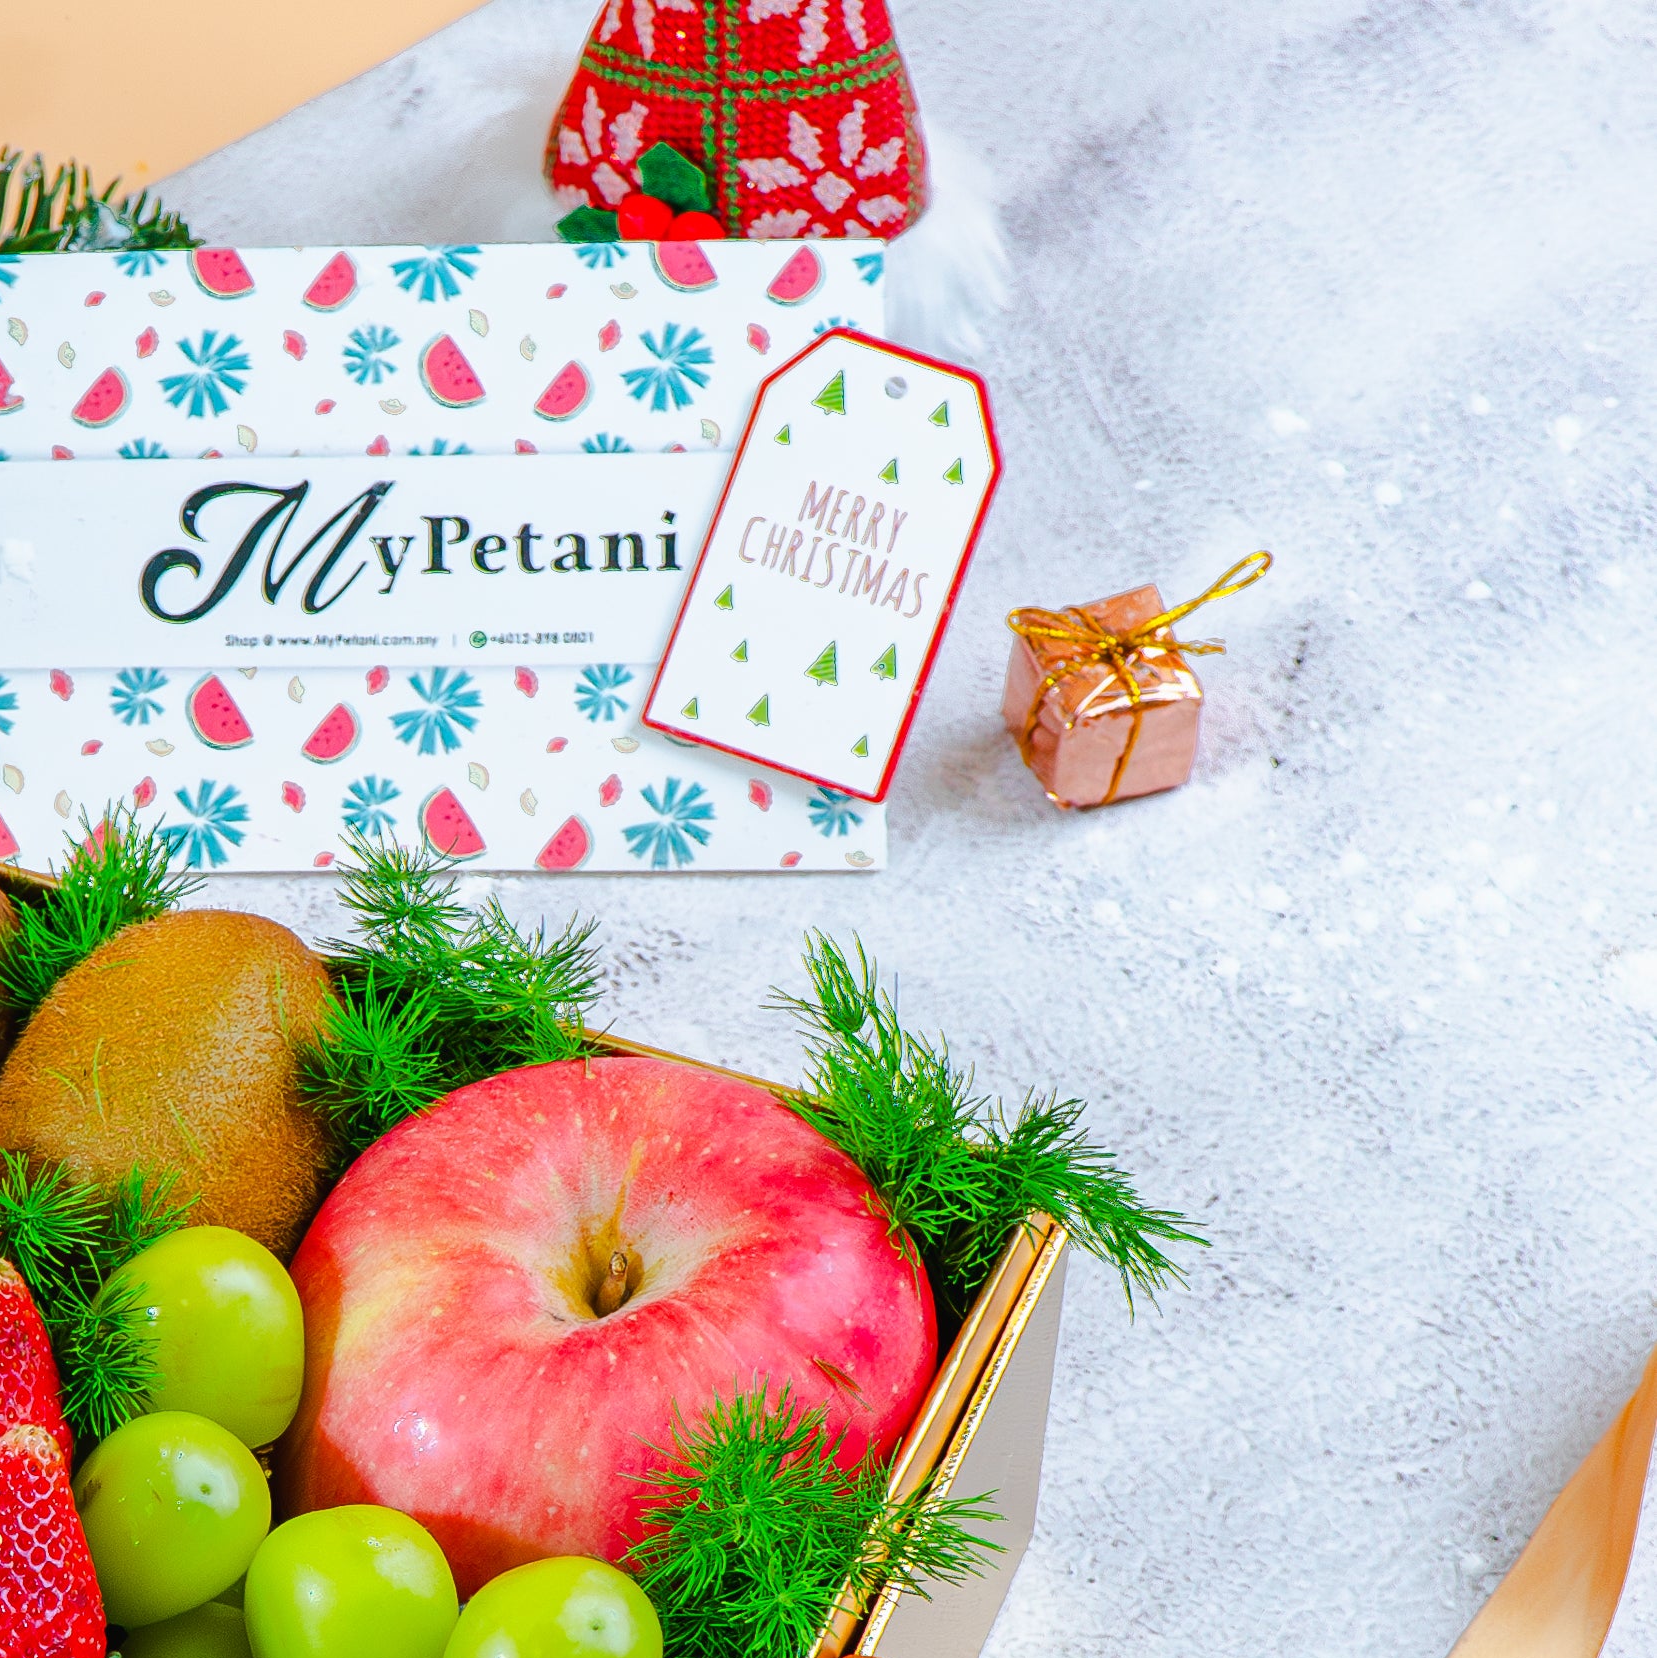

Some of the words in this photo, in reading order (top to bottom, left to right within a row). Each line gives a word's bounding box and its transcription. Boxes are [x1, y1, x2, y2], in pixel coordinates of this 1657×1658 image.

[138, 479, 684, 624] MyPetani
[798, 480, 908, 553] MERRY
[739, 516, 929, 618] CHRISTMAS
[224, 634, 259, 648] Shop
